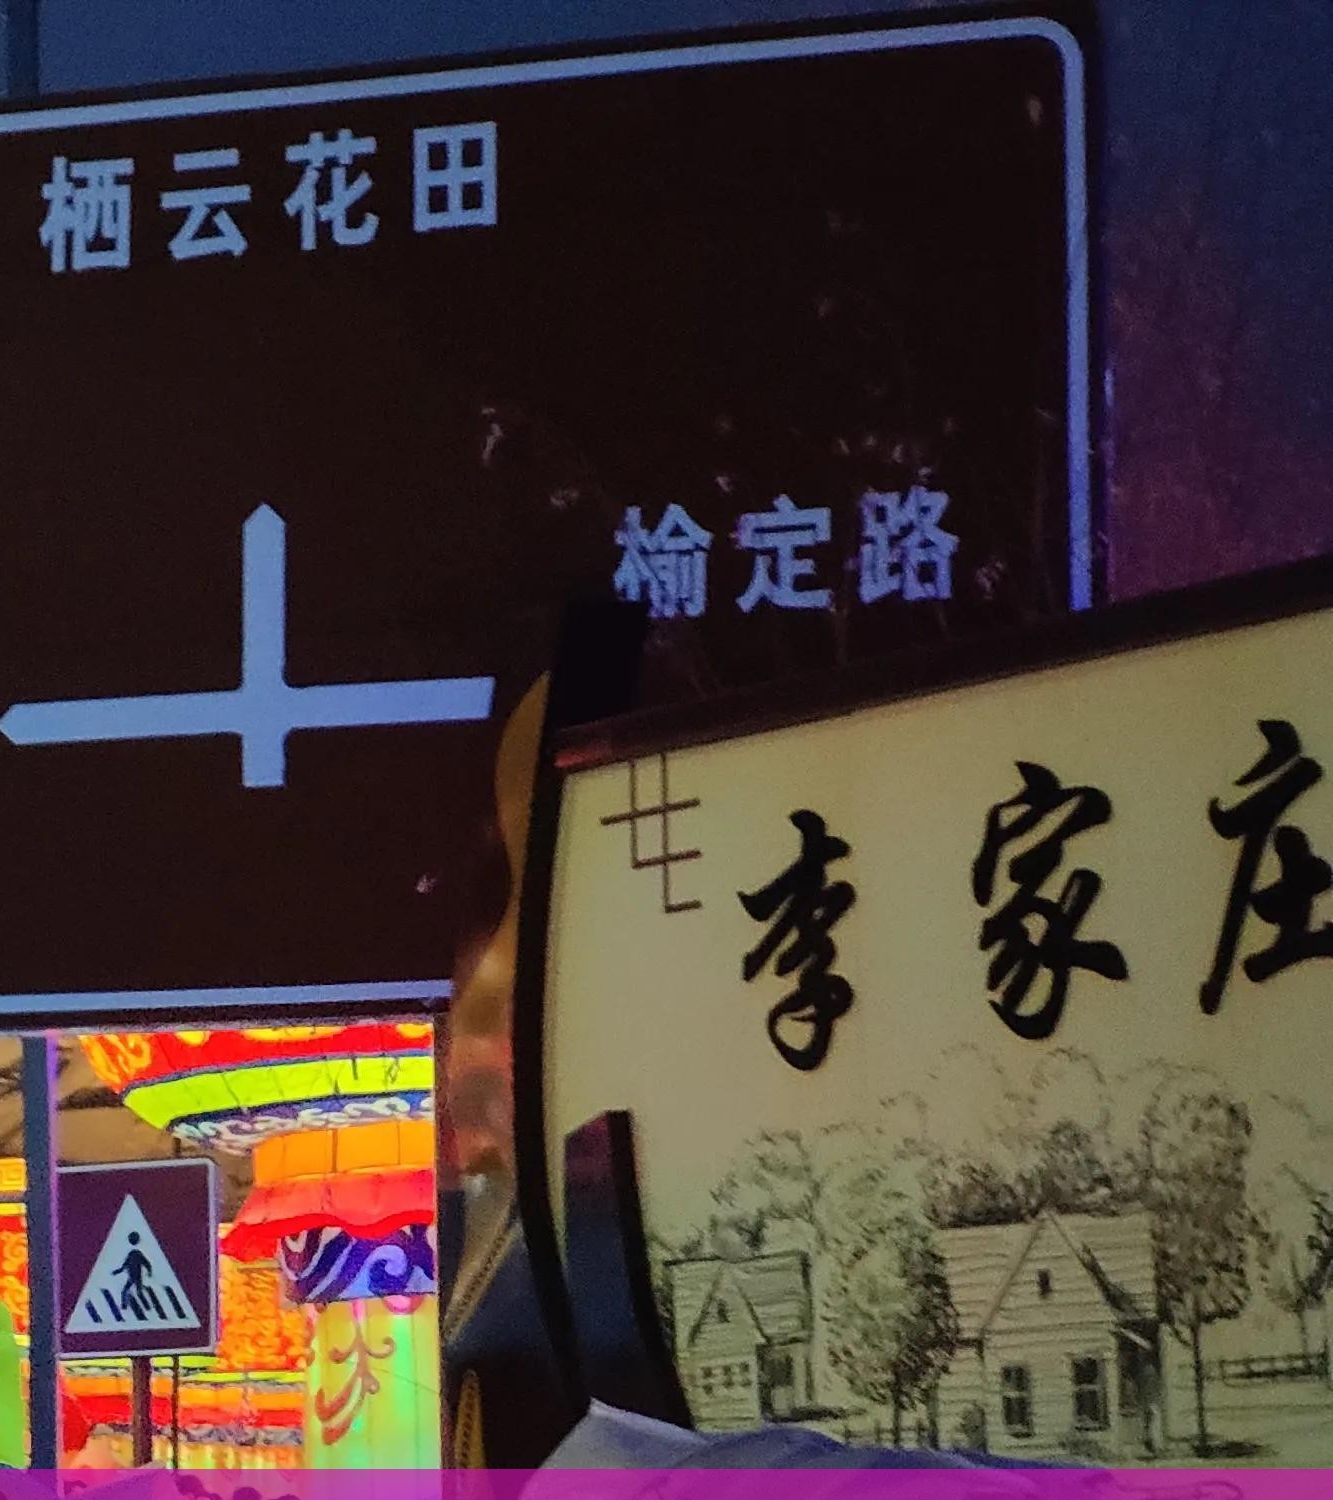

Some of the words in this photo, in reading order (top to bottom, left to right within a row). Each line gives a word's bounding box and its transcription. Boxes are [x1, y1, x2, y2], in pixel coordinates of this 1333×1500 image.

[39, 121, 497, 274] 栖云花田
[613, 486, 960, 619] 榆定路
[738, 719, 1333, 1072] 李家庄
